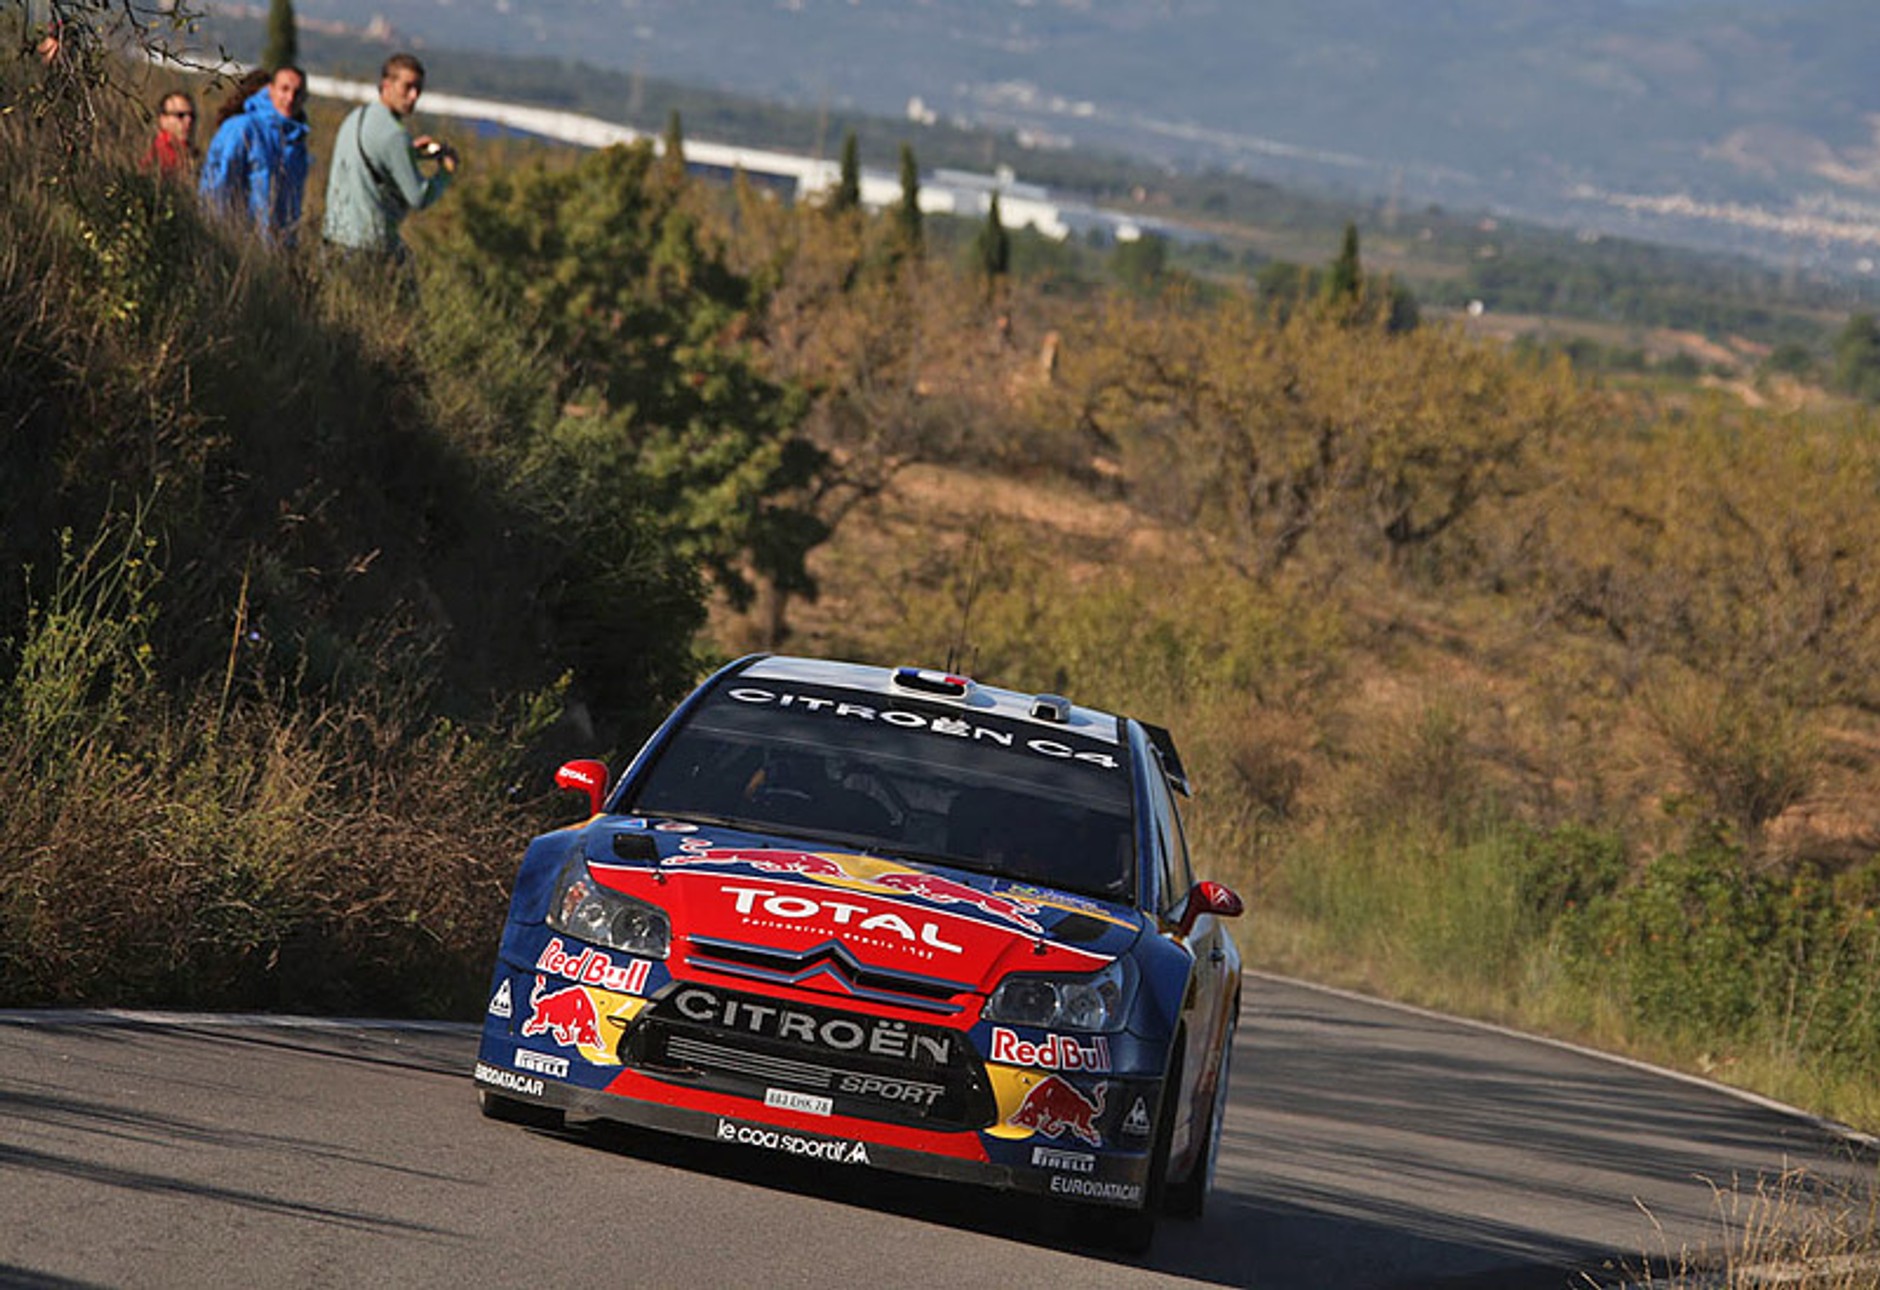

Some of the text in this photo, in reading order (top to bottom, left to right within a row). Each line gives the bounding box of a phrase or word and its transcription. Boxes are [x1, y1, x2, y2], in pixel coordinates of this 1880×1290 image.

[729, 687, 1120, 769] CITROËN C4
[721, 886, 964, 954] TOTAL
[536, 937, 652, 995] Red Bull
[674, 988, 951, 1064] CITROËN
[991, 1027, 1112, 1073] Red Bull
[839, 1077, 945, 1106] SPORT
[717, 1118, 736, 1140] le
[780, 1134, 848, 1161] sportif
[1032, 1146, 1096, 1172] PIRELLI
